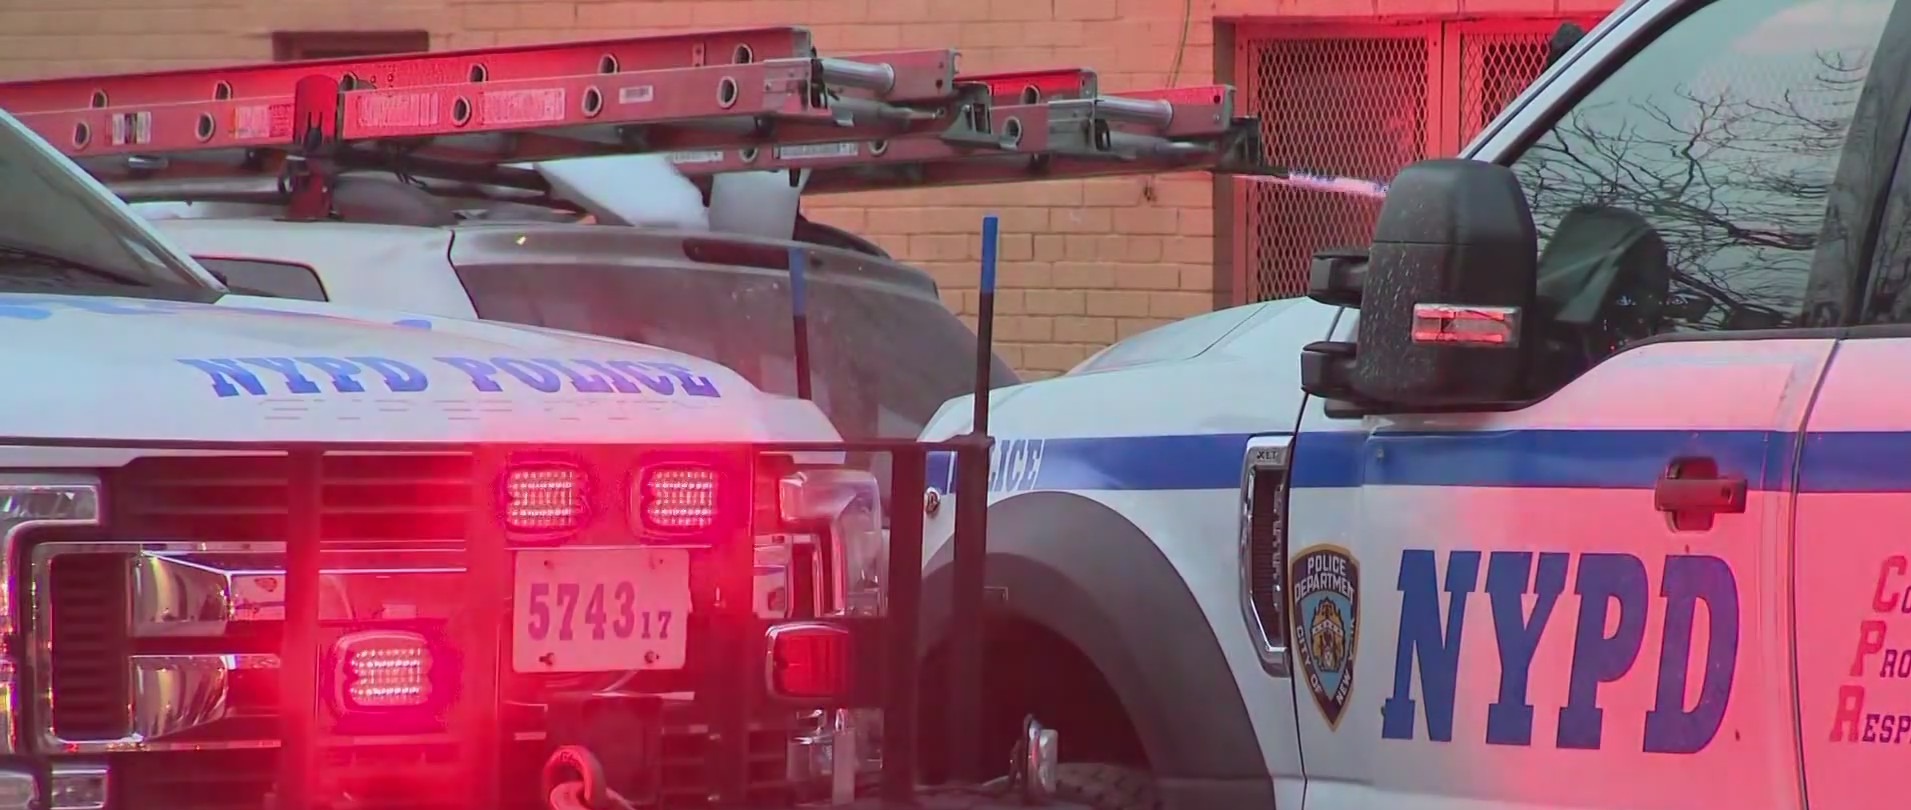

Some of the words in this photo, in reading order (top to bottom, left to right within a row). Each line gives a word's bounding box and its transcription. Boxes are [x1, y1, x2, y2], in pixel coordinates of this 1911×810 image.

[177, 357, 429, 398] NYPD
[433, 357, 721, 398] POLICE
[1256, 451, 1278, 460] XLT
[1307, 554, 1346, 577] POLICE
[1294, 573, 1355, 605] DEPARTMENT
[528, 581, 635, 641] 5743
[641, 611, 672, 640] 17
[1382, 549, 1739, 754] NYPD
[1335, 669, 1352, 706] NEW
